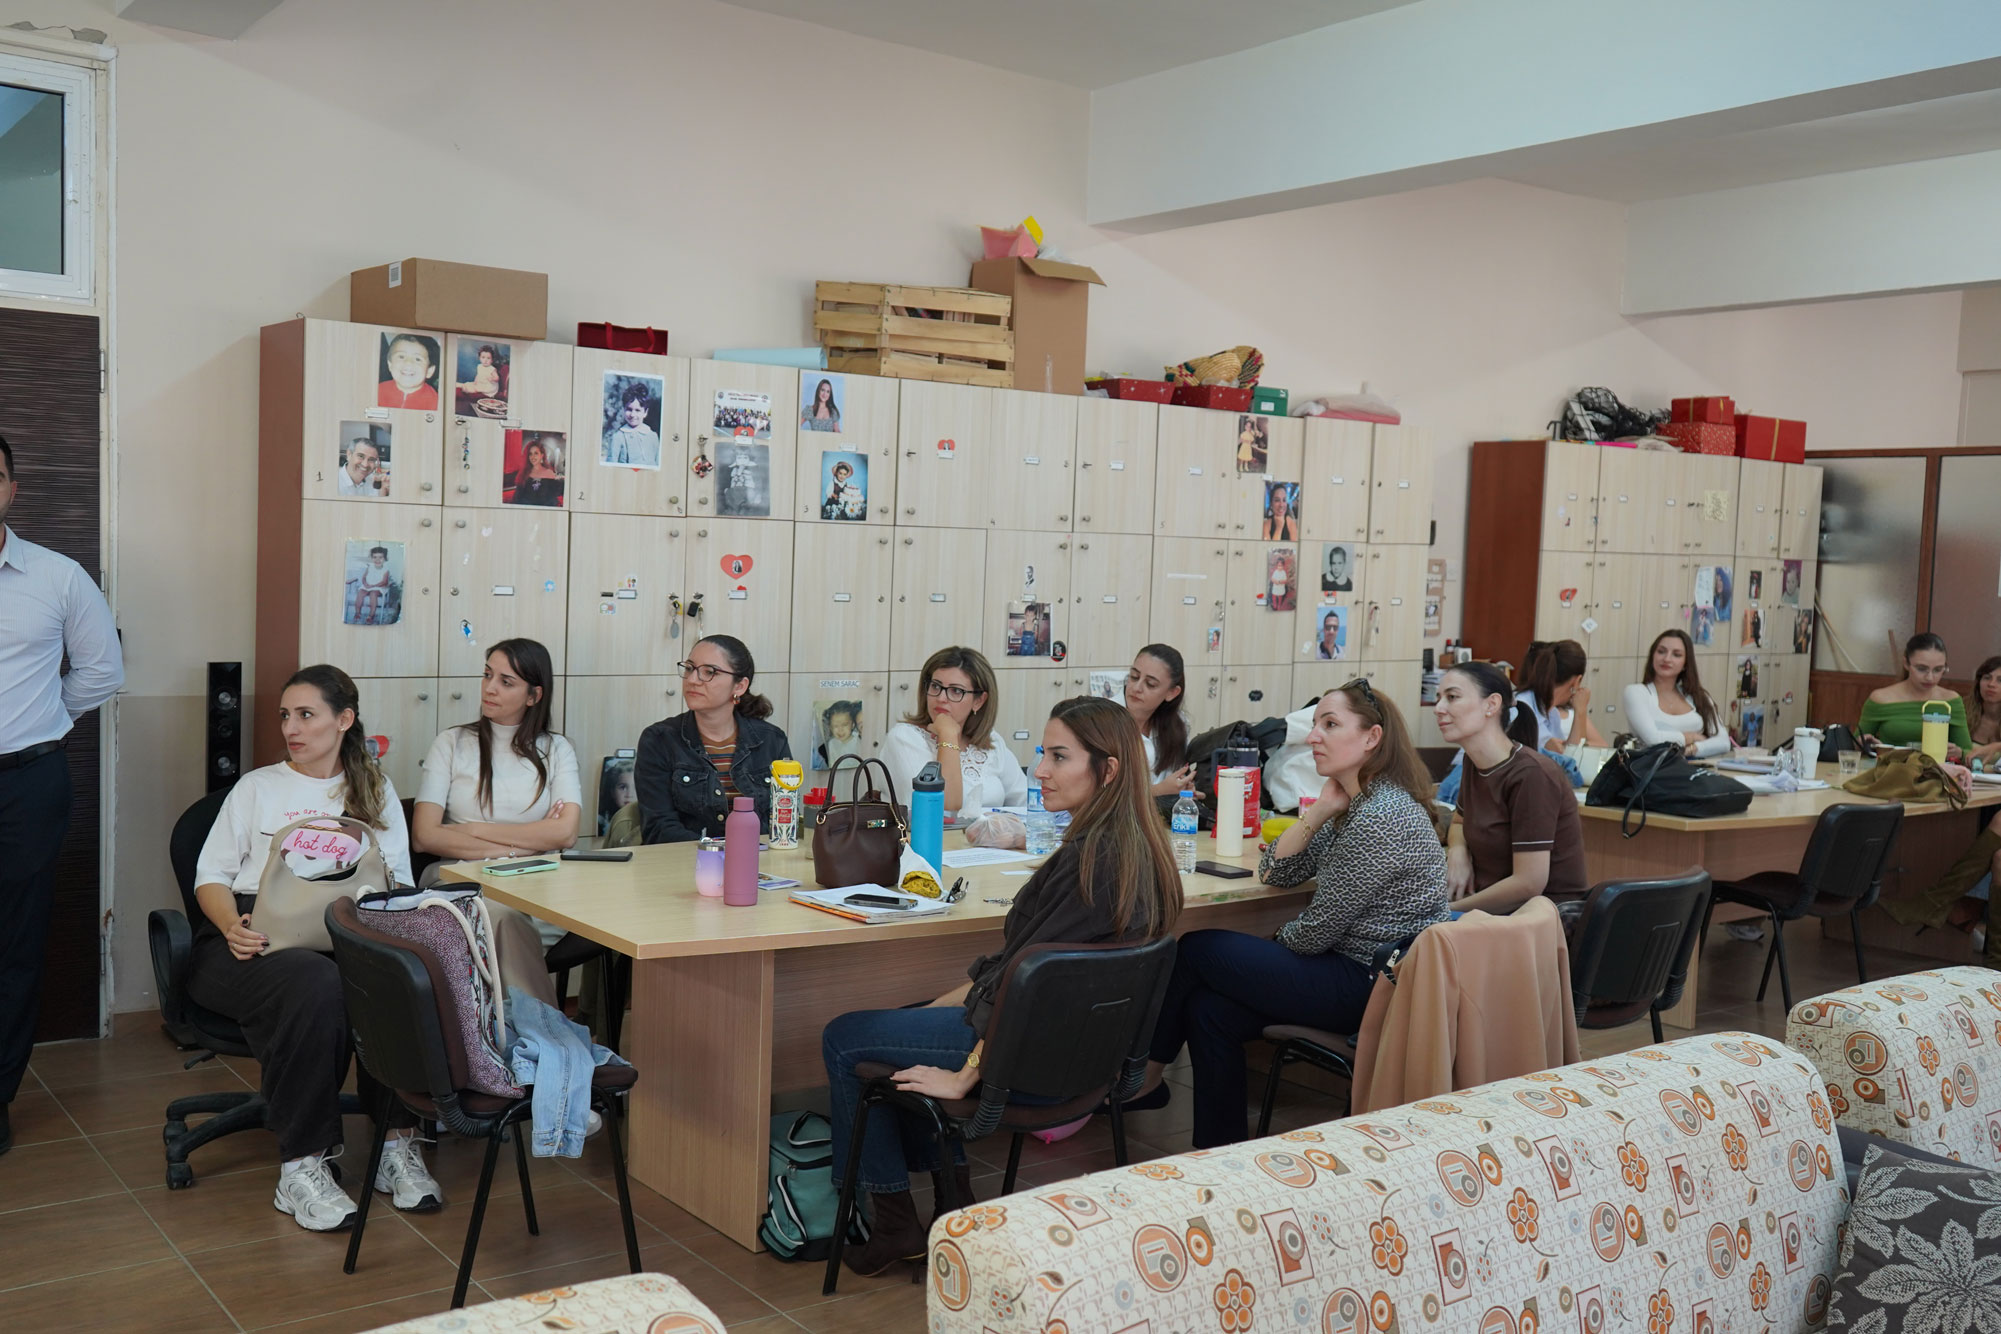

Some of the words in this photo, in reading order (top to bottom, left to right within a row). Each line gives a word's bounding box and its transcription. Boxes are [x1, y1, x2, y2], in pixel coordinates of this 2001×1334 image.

[284, 811, 300, 820] you
[303, 808, 318, 816] are
[293, 831, 320, 850] hot
[322, 837, 348, 859] dog
